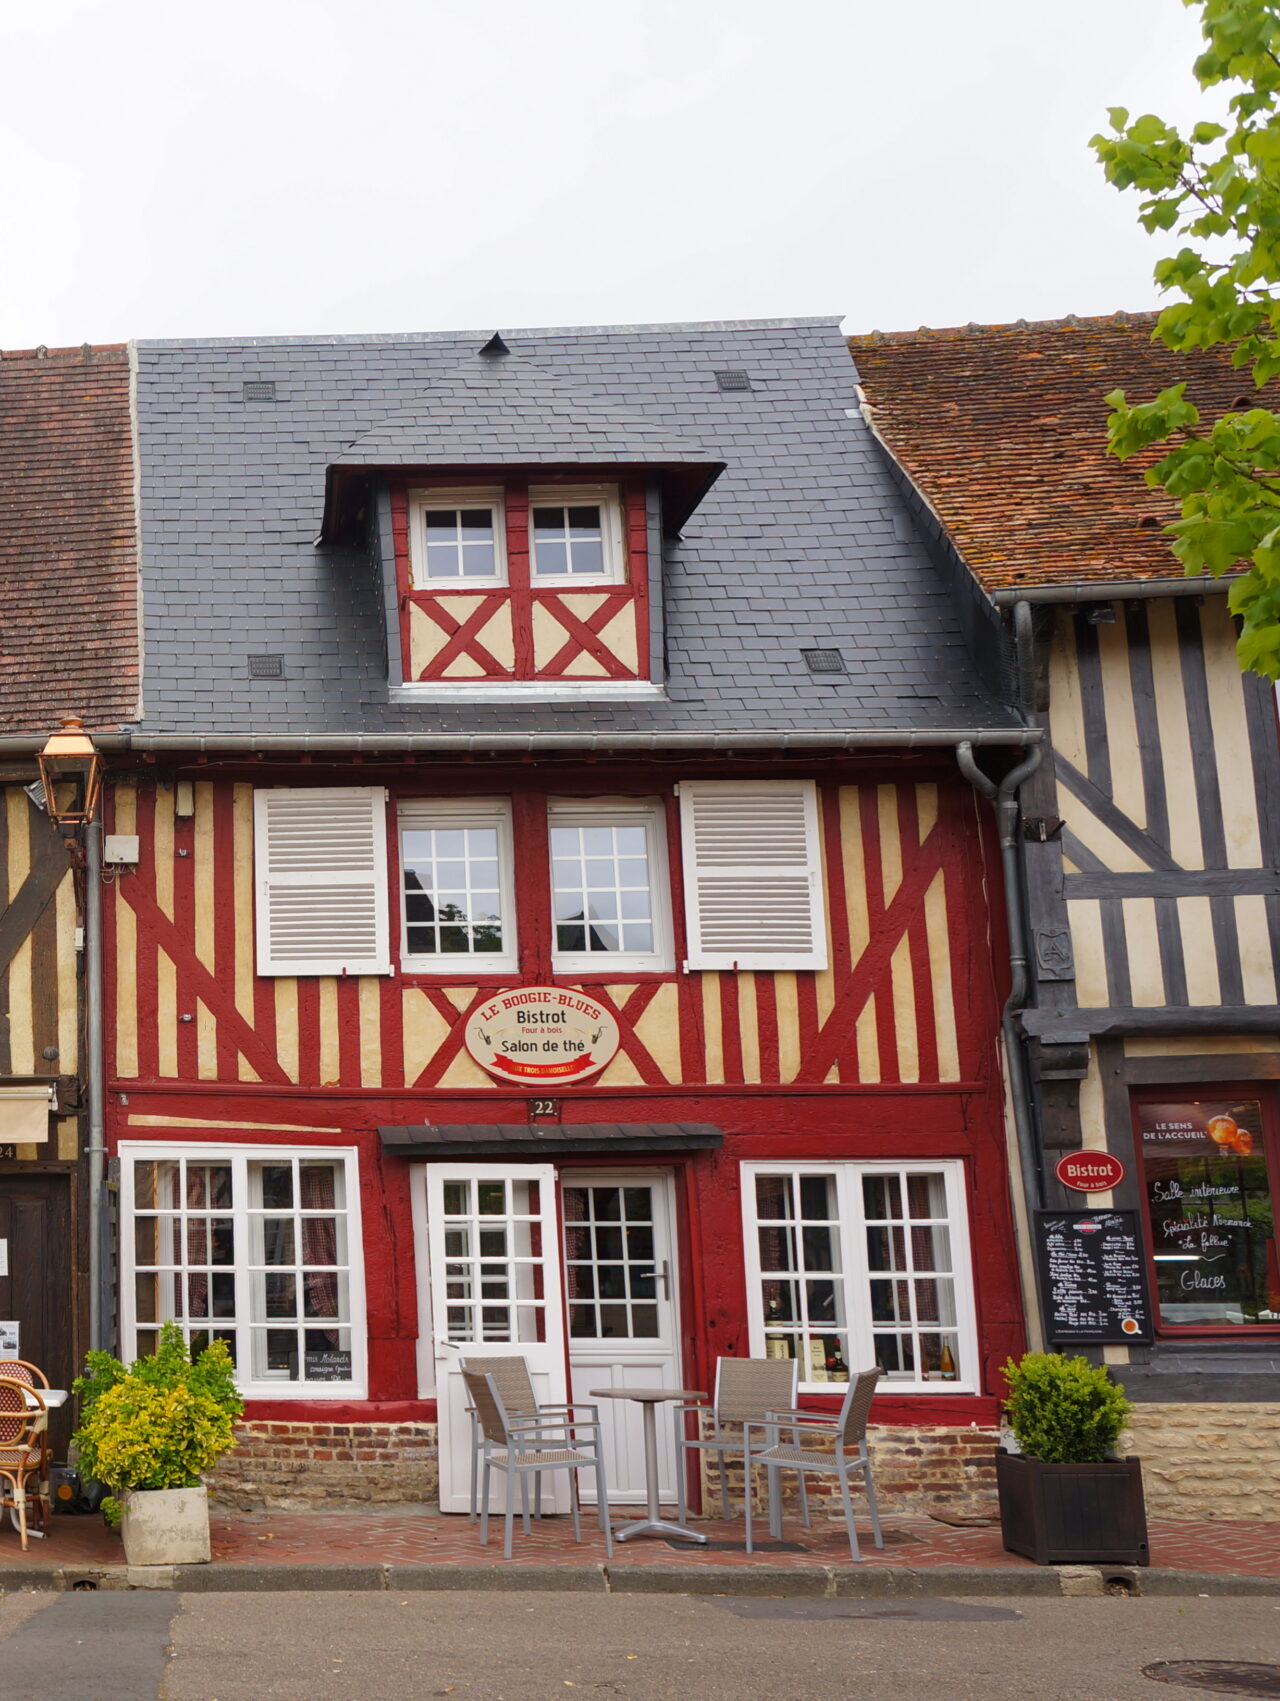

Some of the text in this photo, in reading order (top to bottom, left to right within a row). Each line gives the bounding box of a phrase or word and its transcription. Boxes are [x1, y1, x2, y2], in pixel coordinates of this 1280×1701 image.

[480, 992, 601, 1021] LE BOOGIE-BLUES
[517, 1011, 566, 1024] Bistrot
[501, 1040, 585, 1053] Salon de thé
[535, 1102, 553, 1114] 22
[1168, 1122, 1192, 1130] SENS
[1143, 1132, 1156, 1140] DE
[1067, 1164, 1113, 1177] Bistrot
[1153, 1180, 1186, 1203] Salle
[1180, 1270, 1226, 1290] Glaces
